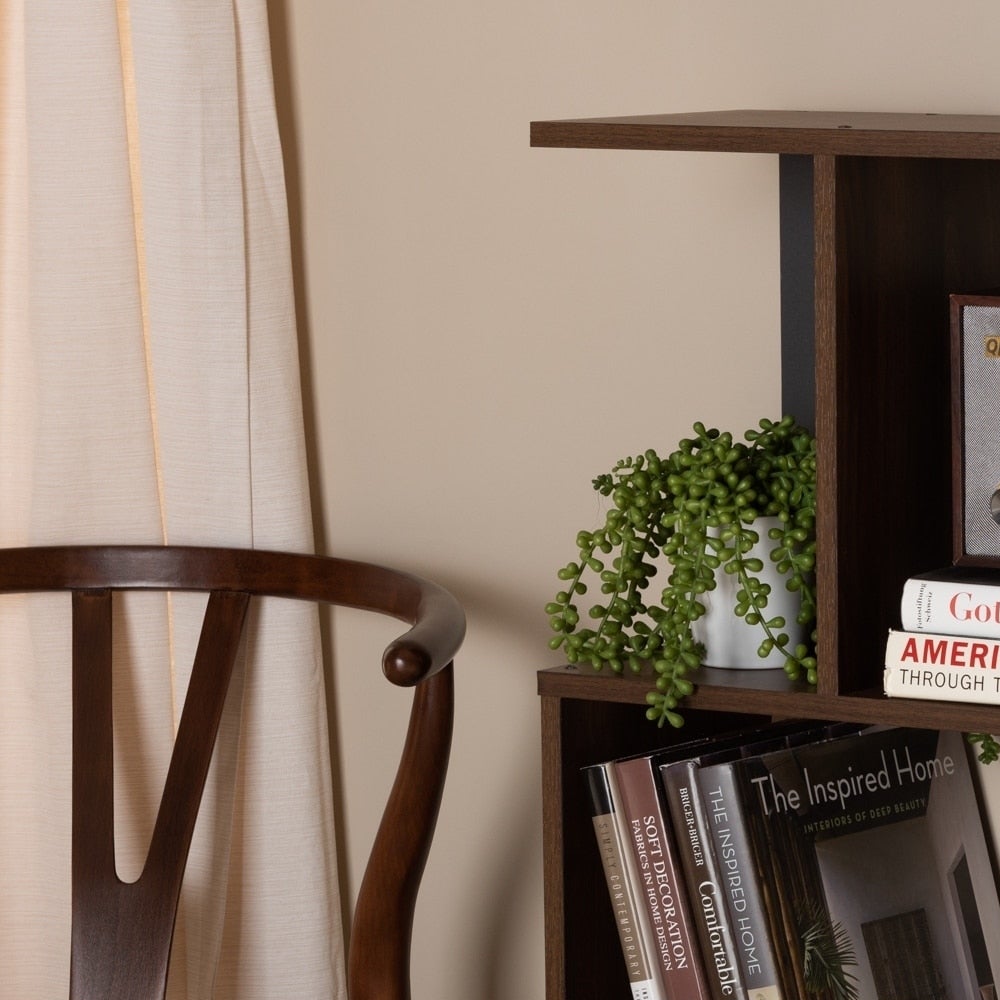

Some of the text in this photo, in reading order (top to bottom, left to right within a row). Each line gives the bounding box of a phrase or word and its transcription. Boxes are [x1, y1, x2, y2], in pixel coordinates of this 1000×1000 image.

[900, 669, 985, 692] THROUGH
[751, 746, 955, 816] The Inspired Home
[803, 798, 926, 834] INTERIORS OF DEEP BEAUTY
[598, 823, 641, 976] SIMPLY CONTEMPORARY
[631, 819, 673, 972] FABRICS IN HOME DESIGN
[643, 815, 689, 970] SOFT DECORATION
[698, 881, 737, 995] Comfortable
[709, 785, 762, 976] THE INSPIRED HOME
